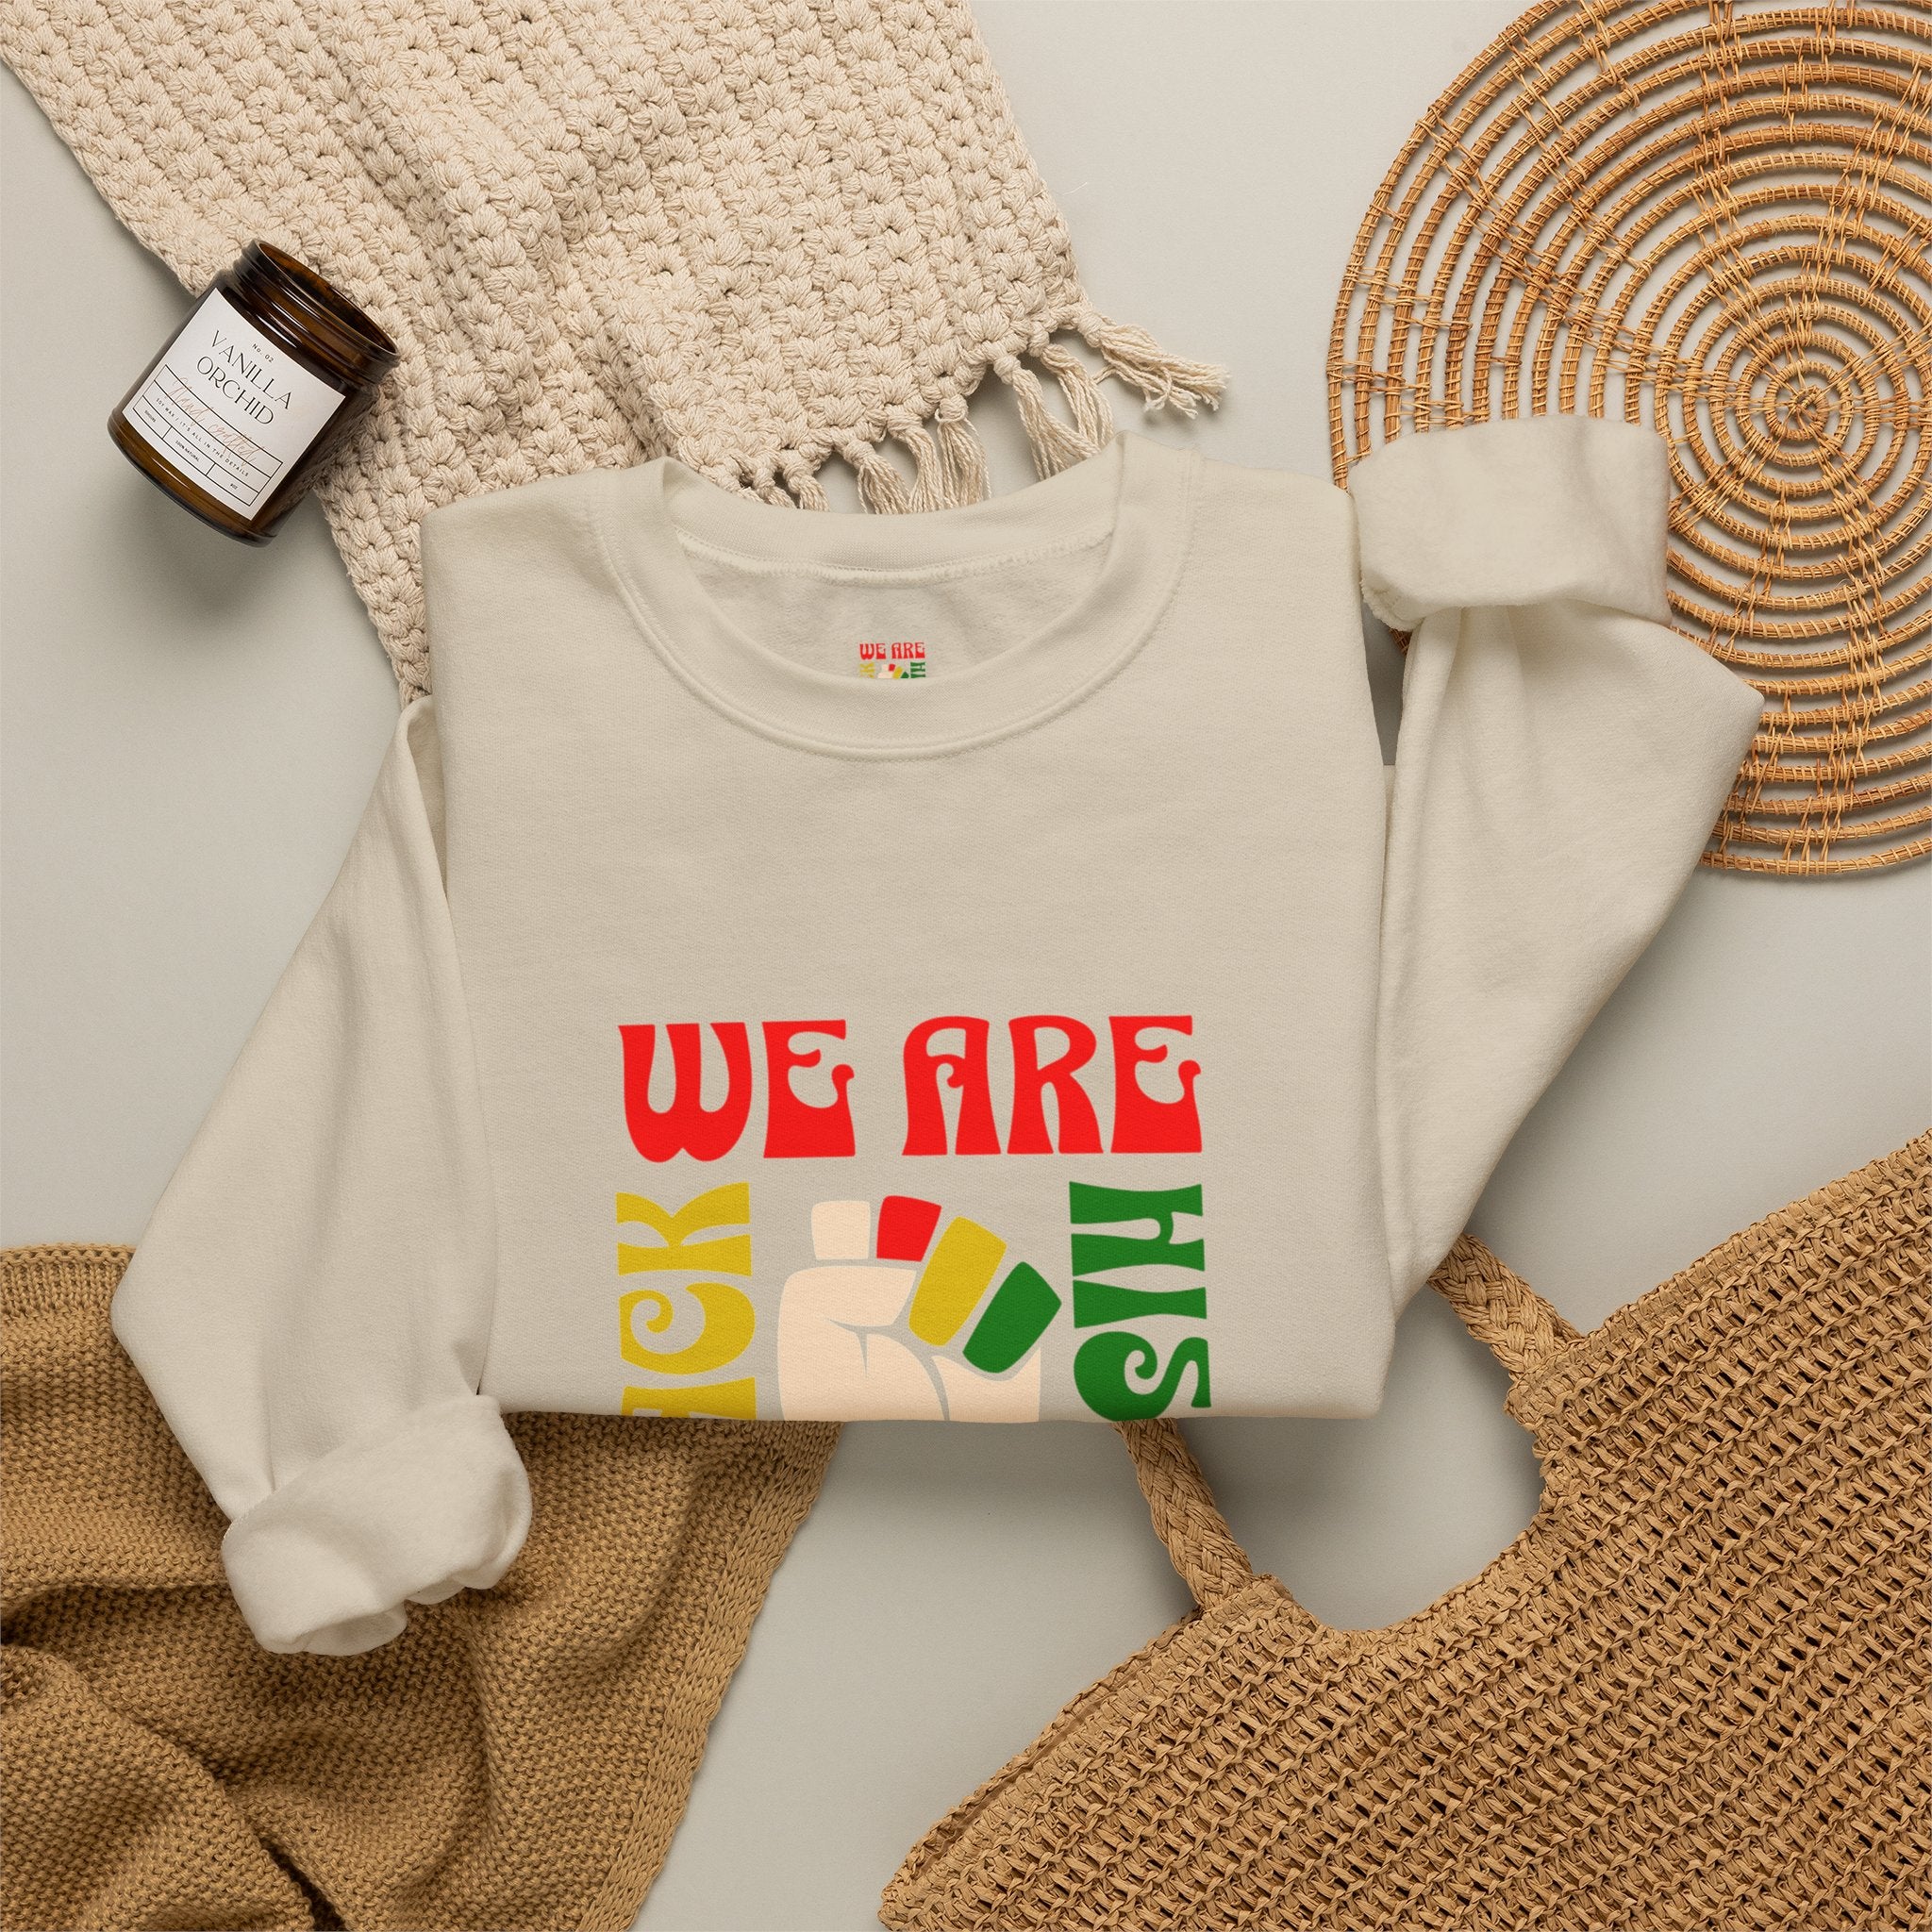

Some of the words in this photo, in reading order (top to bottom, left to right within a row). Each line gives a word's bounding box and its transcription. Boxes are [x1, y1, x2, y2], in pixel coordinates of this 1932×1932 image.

[212, 330, 291, 409] VANILLA
[252, 343, 261, 355] No.
[264, 354, 275, 363] 02
[197, 356, 275, 425] ORCHID
[192, 432, 202, 442] ALL
[203, 440, 210, 448] IN
[212, 448, 224, 458] THE
[225, 458, 249, 476] DETAILS
[859, 643, 887, 660] WE
[891, 642, 926, 659] ARE
[618, 1019, 856, 1163] WE
[902, 1015, 1203, 1157] ARE
[1069, 1181, 1211, 1422] HIS
